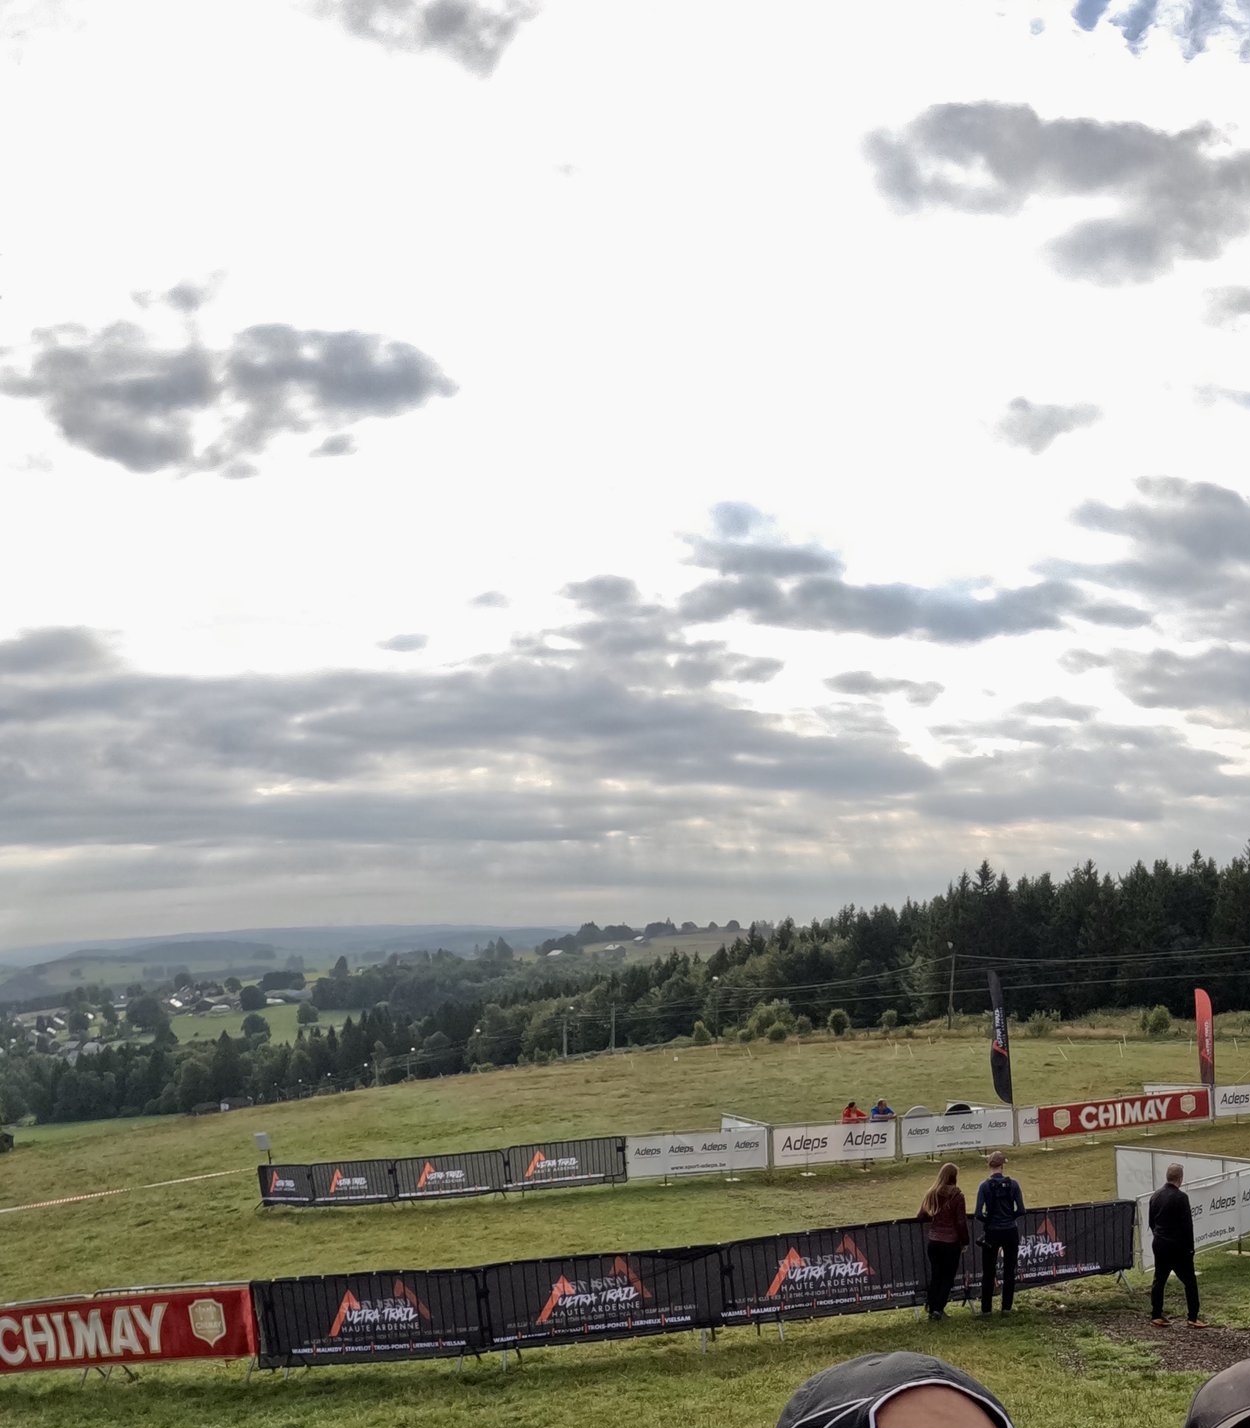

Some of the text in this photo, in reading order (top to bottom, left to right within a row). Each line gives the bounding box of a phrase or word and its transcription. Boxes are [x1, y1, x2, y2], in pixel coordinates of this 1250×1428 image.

[1220, 1092, 1249, 1105] Adeps
[1023, 1117, 1039, 1126] Adep
[1078, 1097, 1172, 1130] CHIMAY
[907, 1127, 930, 1136] Adeps
[960, 1122, 982, 1131] Adeps
[987, 1120, 1007, 1129] Adeps
[634, 1140, 760, 1156] Adeps Adeps Adeps Adeps
[781, 1130, 887, 1152] Adeps Adeps
[1209, 1195, 1236, 1212] Adeps
[788, 1261, 868, 1283] ULTRA TRAIL
[781, 1276, 868, 1292] HAUTE ARDENNE
[557, 1286, 639, 1308] ULTRA TRAIL
[346, 1307, 419, 1324] ULTRA TRAIL
[551, 1301, 641, 1318] HAUTE ARDENNE
[0, 1302, 169, 1367] CHIMAY
[341, 1322, 420, 1333] HAUTE ARDENNE
